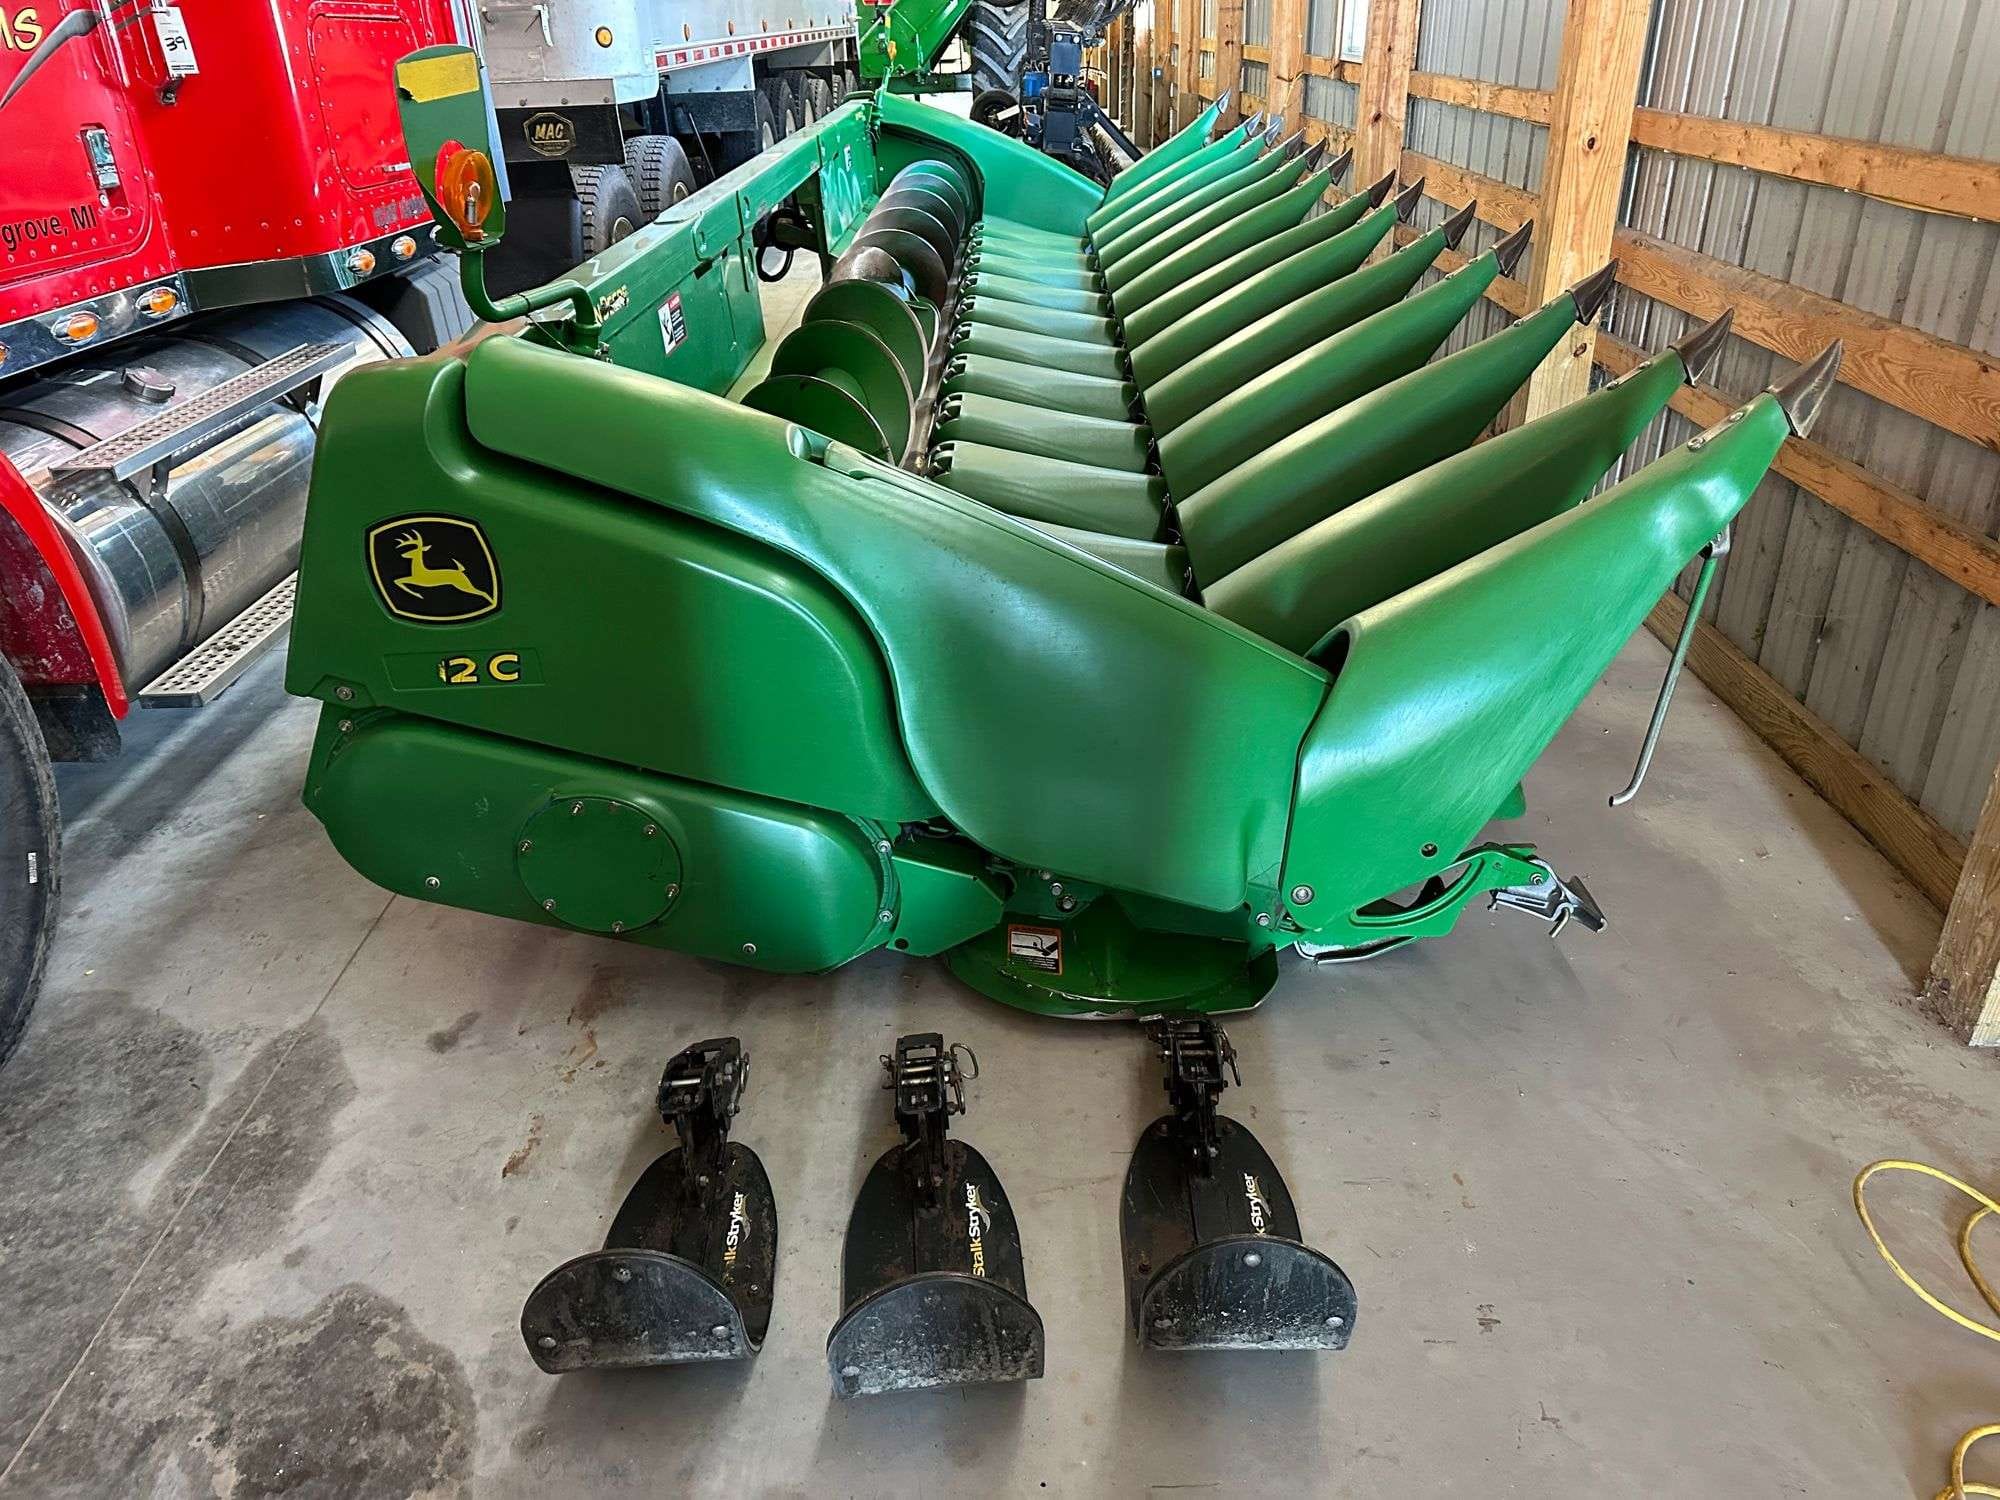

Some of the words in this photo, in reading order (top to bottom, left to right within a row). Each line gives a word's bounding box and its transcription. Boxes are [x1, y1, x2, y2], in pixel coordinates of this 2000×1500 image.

[164, 36, 187, 51] 39
[535, 123, 563, 140] MAC
[70, 204, 97, 230] MI
[965, 1183, 985, 1278] StalkStryker
